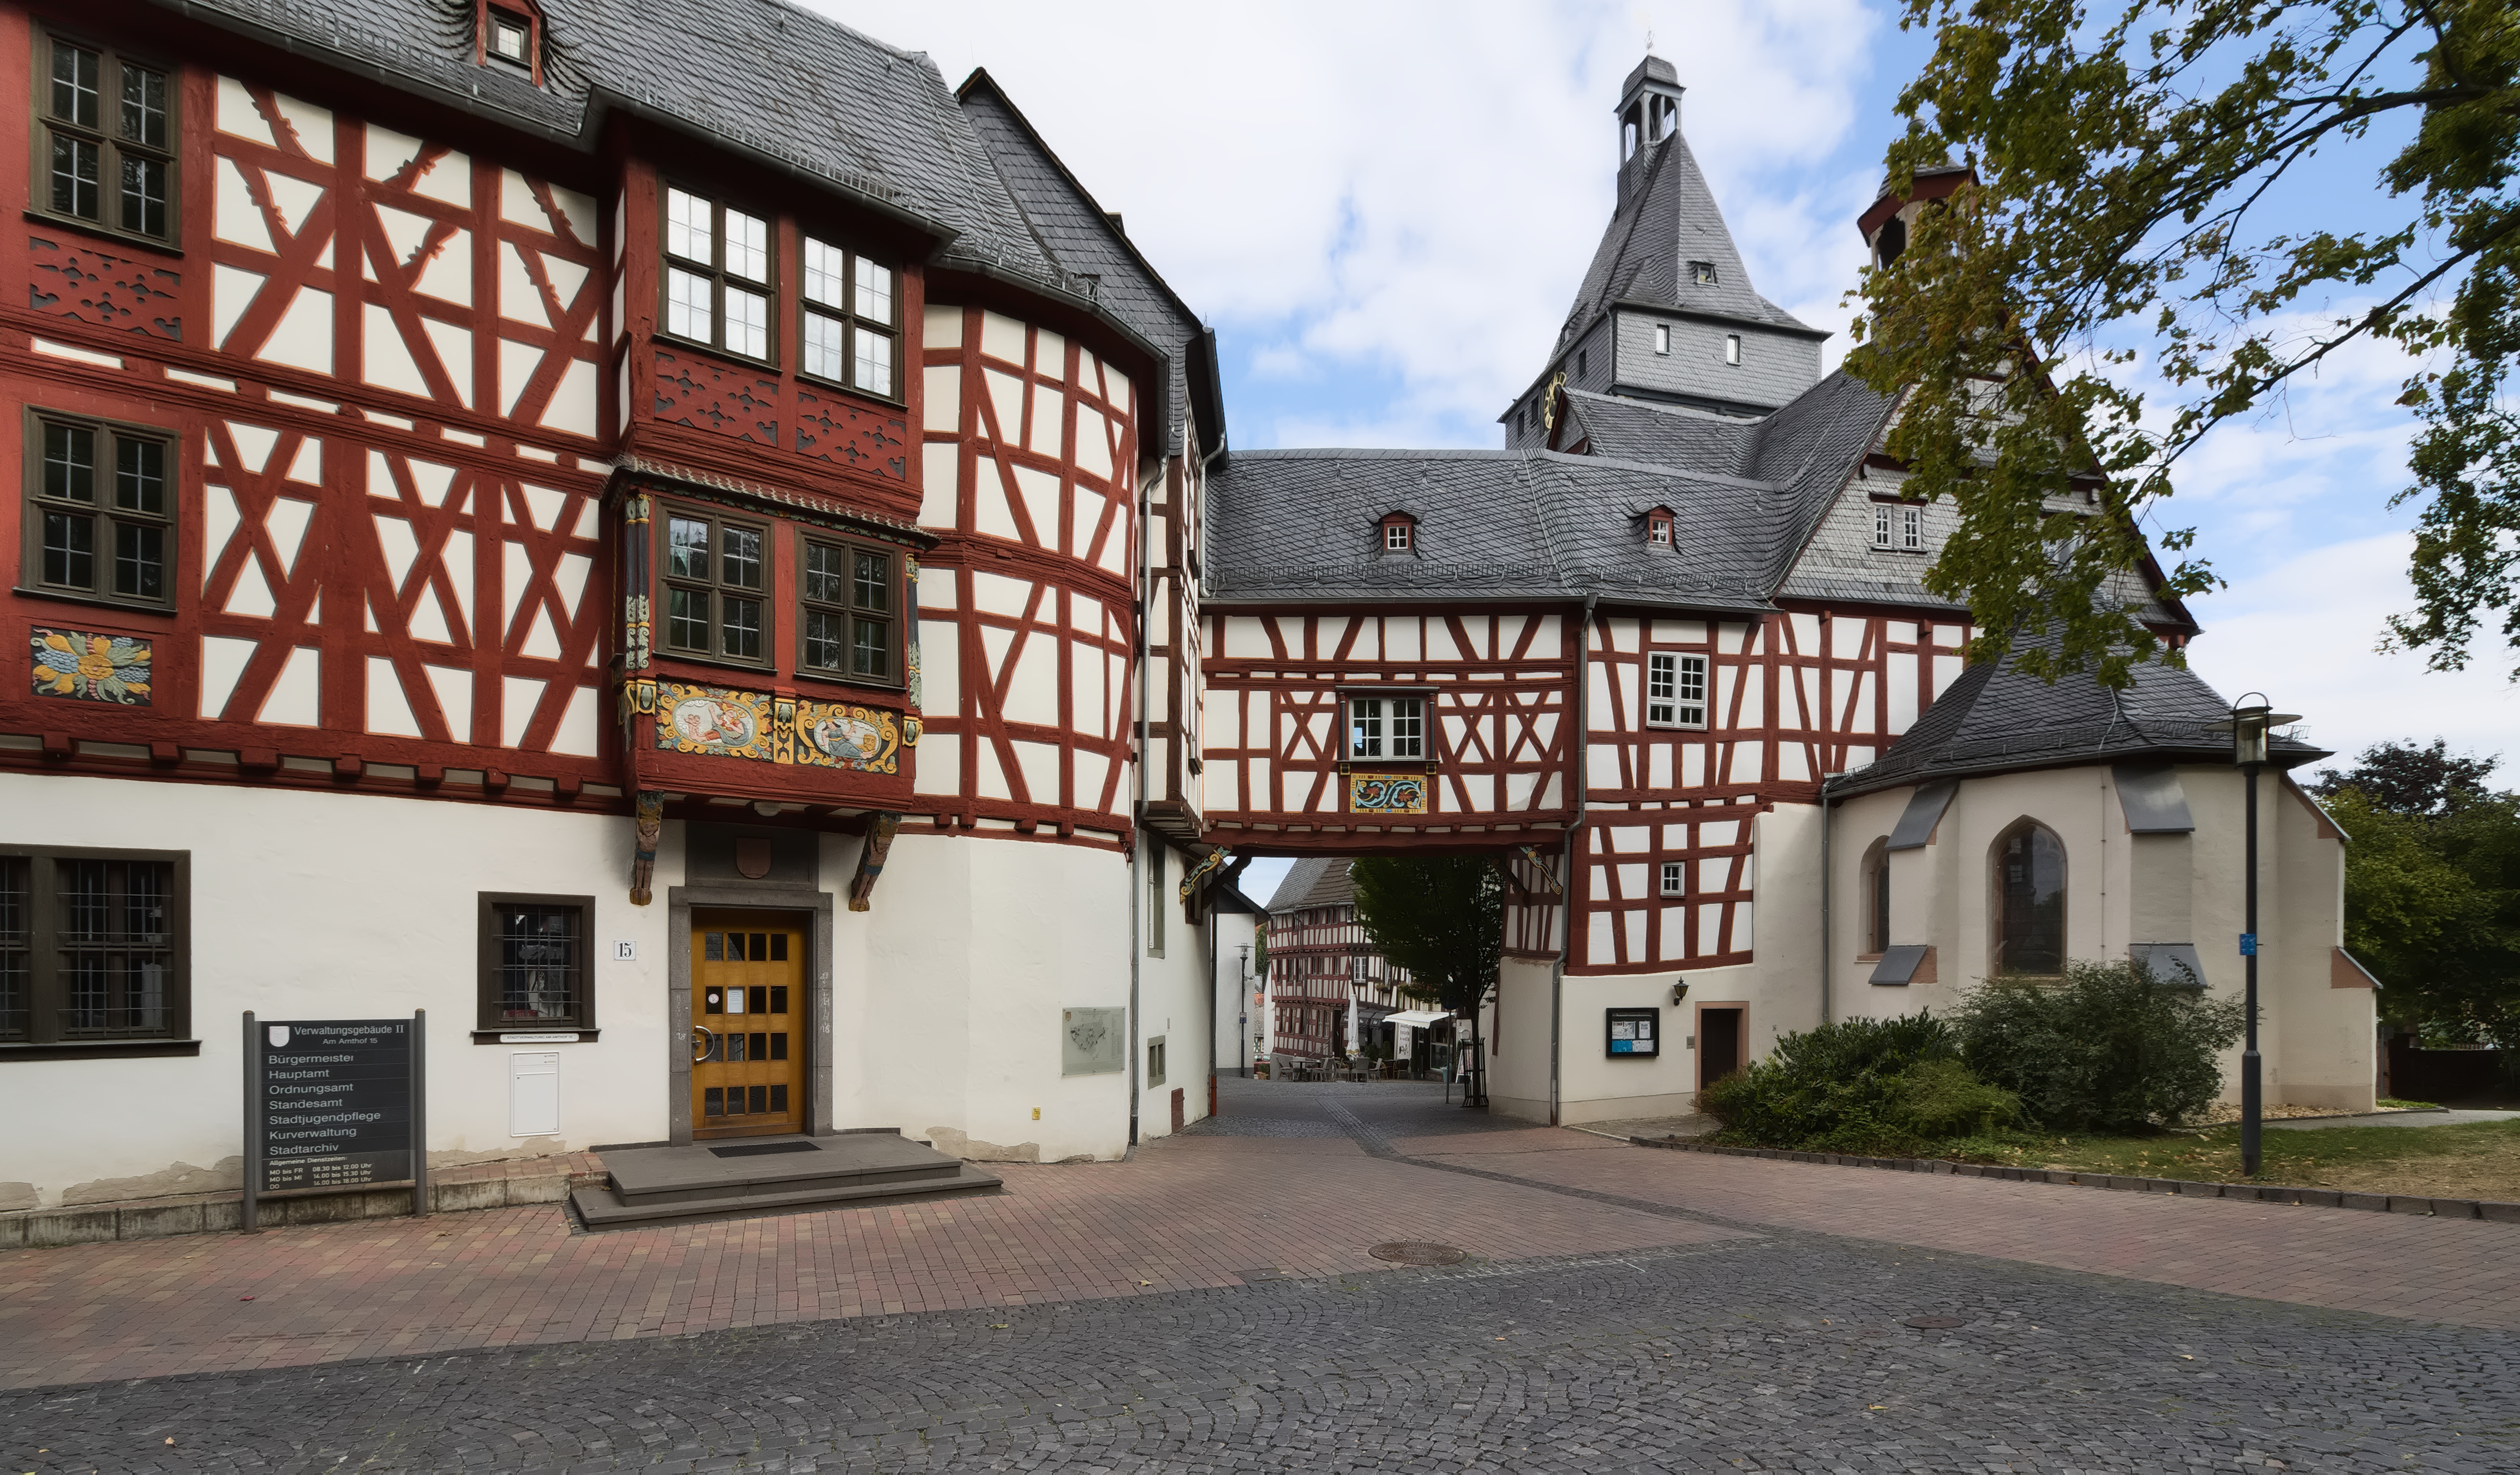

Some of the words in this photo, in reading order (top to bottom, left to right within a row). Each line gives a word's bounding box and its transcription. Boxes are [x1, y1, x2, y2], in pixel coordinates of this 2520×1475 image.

[618, 943, 632, 957] 15
[295, 1025, 392, 1036] Verwaltungsgebäude
[396, 1024, 404, 1033] II
[269, 1054, 354, 1065] Bürgermeister
[269, 1069, 330, 1080] Hauptamt
[269, 1083, 354, 1095] Ordnungsamt
[269, 1099, 343, 1110] Standesamt
[269, 1112, 381, 1125] Stadtjugendpflege
[270, 1128, 357, 1140] Kurverwaltung
[270, 1143, 339, 1155] Stadtarchiv
